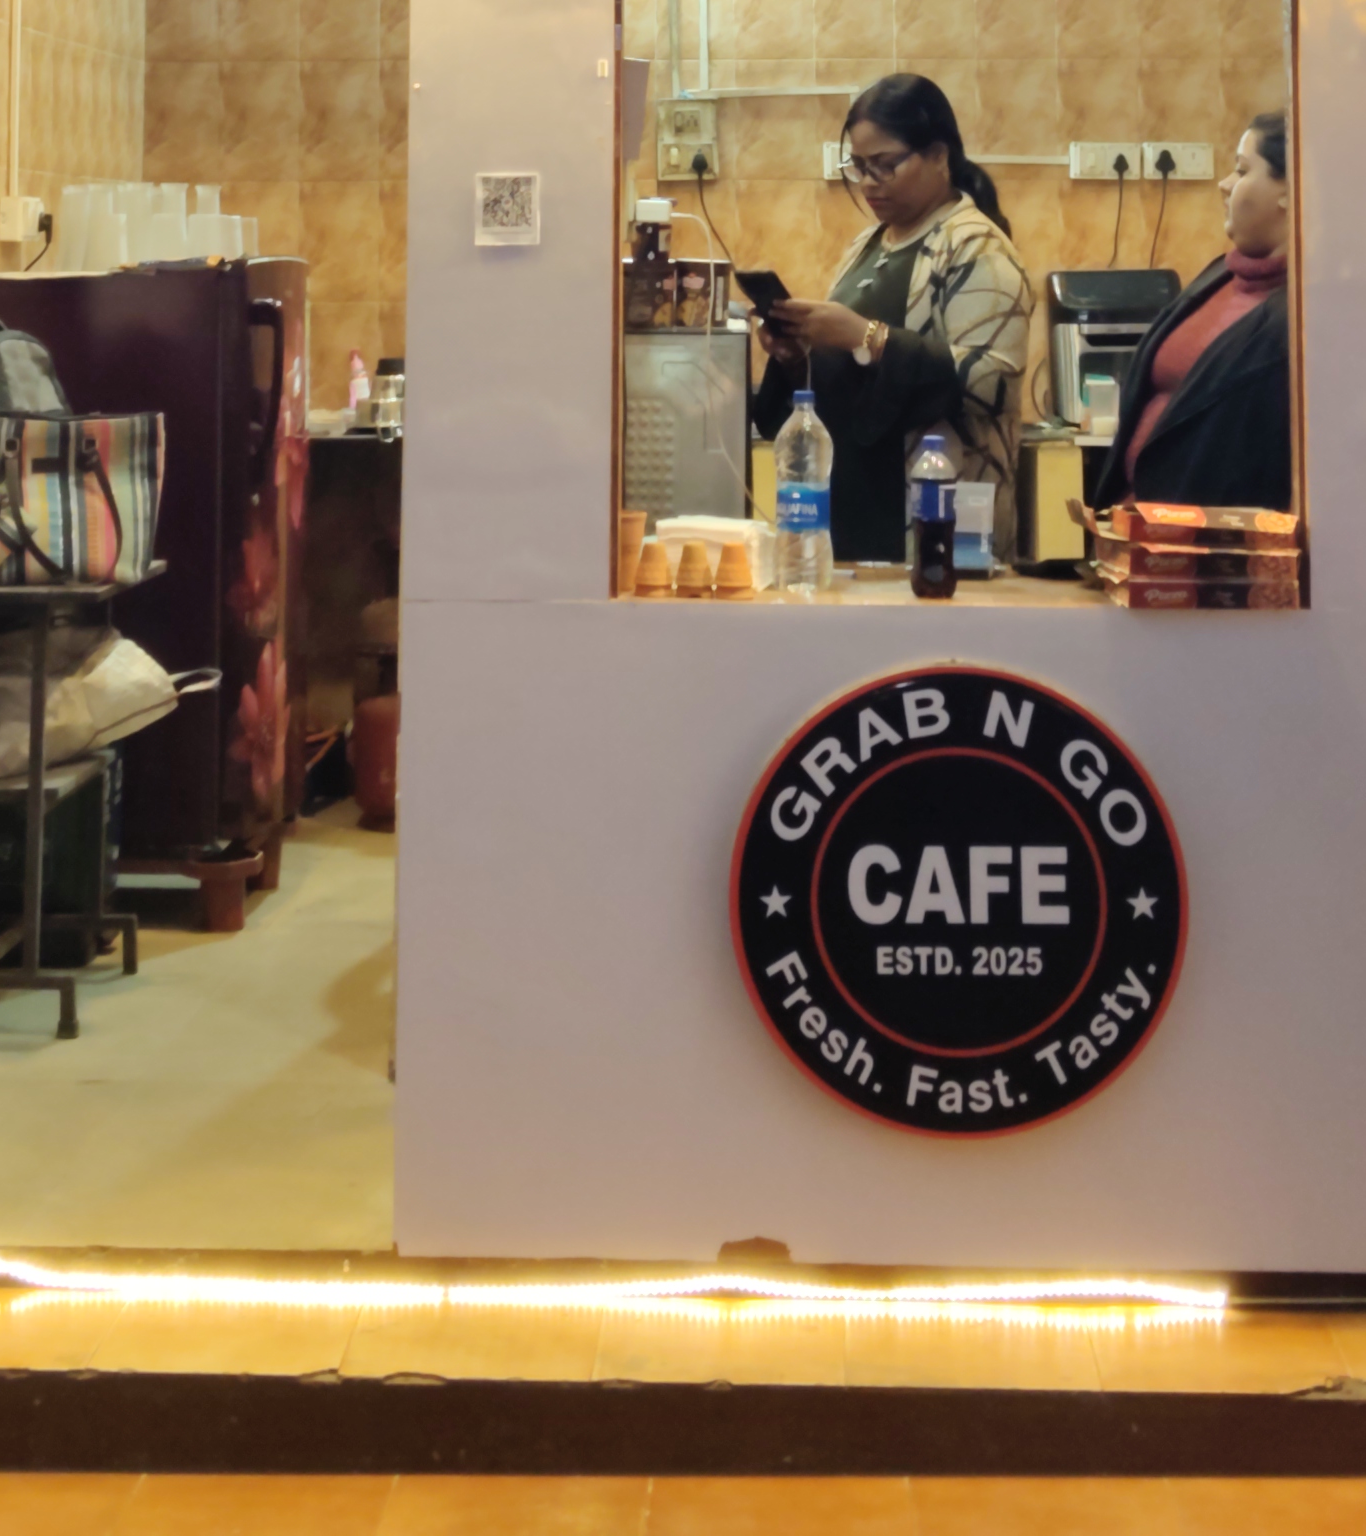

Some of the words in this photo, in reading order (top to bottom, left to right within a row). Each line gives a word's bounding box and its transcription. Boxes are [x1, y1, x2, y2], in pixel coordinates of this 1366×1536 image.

[770, 688, 951, 842] GRAB
[982, 689, 1035, 748] N
[1060, 739, 1147, 846] GO
[846, 843, 1071, 926] CAFE
[876, 947, 962, 975] ESTD.
[972, 947, 1043, 975] 2025
[765, 950, 883, 1093] Fresh.
[906, 1065, 1028, 1114] Fast.
[1035, 963, 1157, 1085] Tasty.
